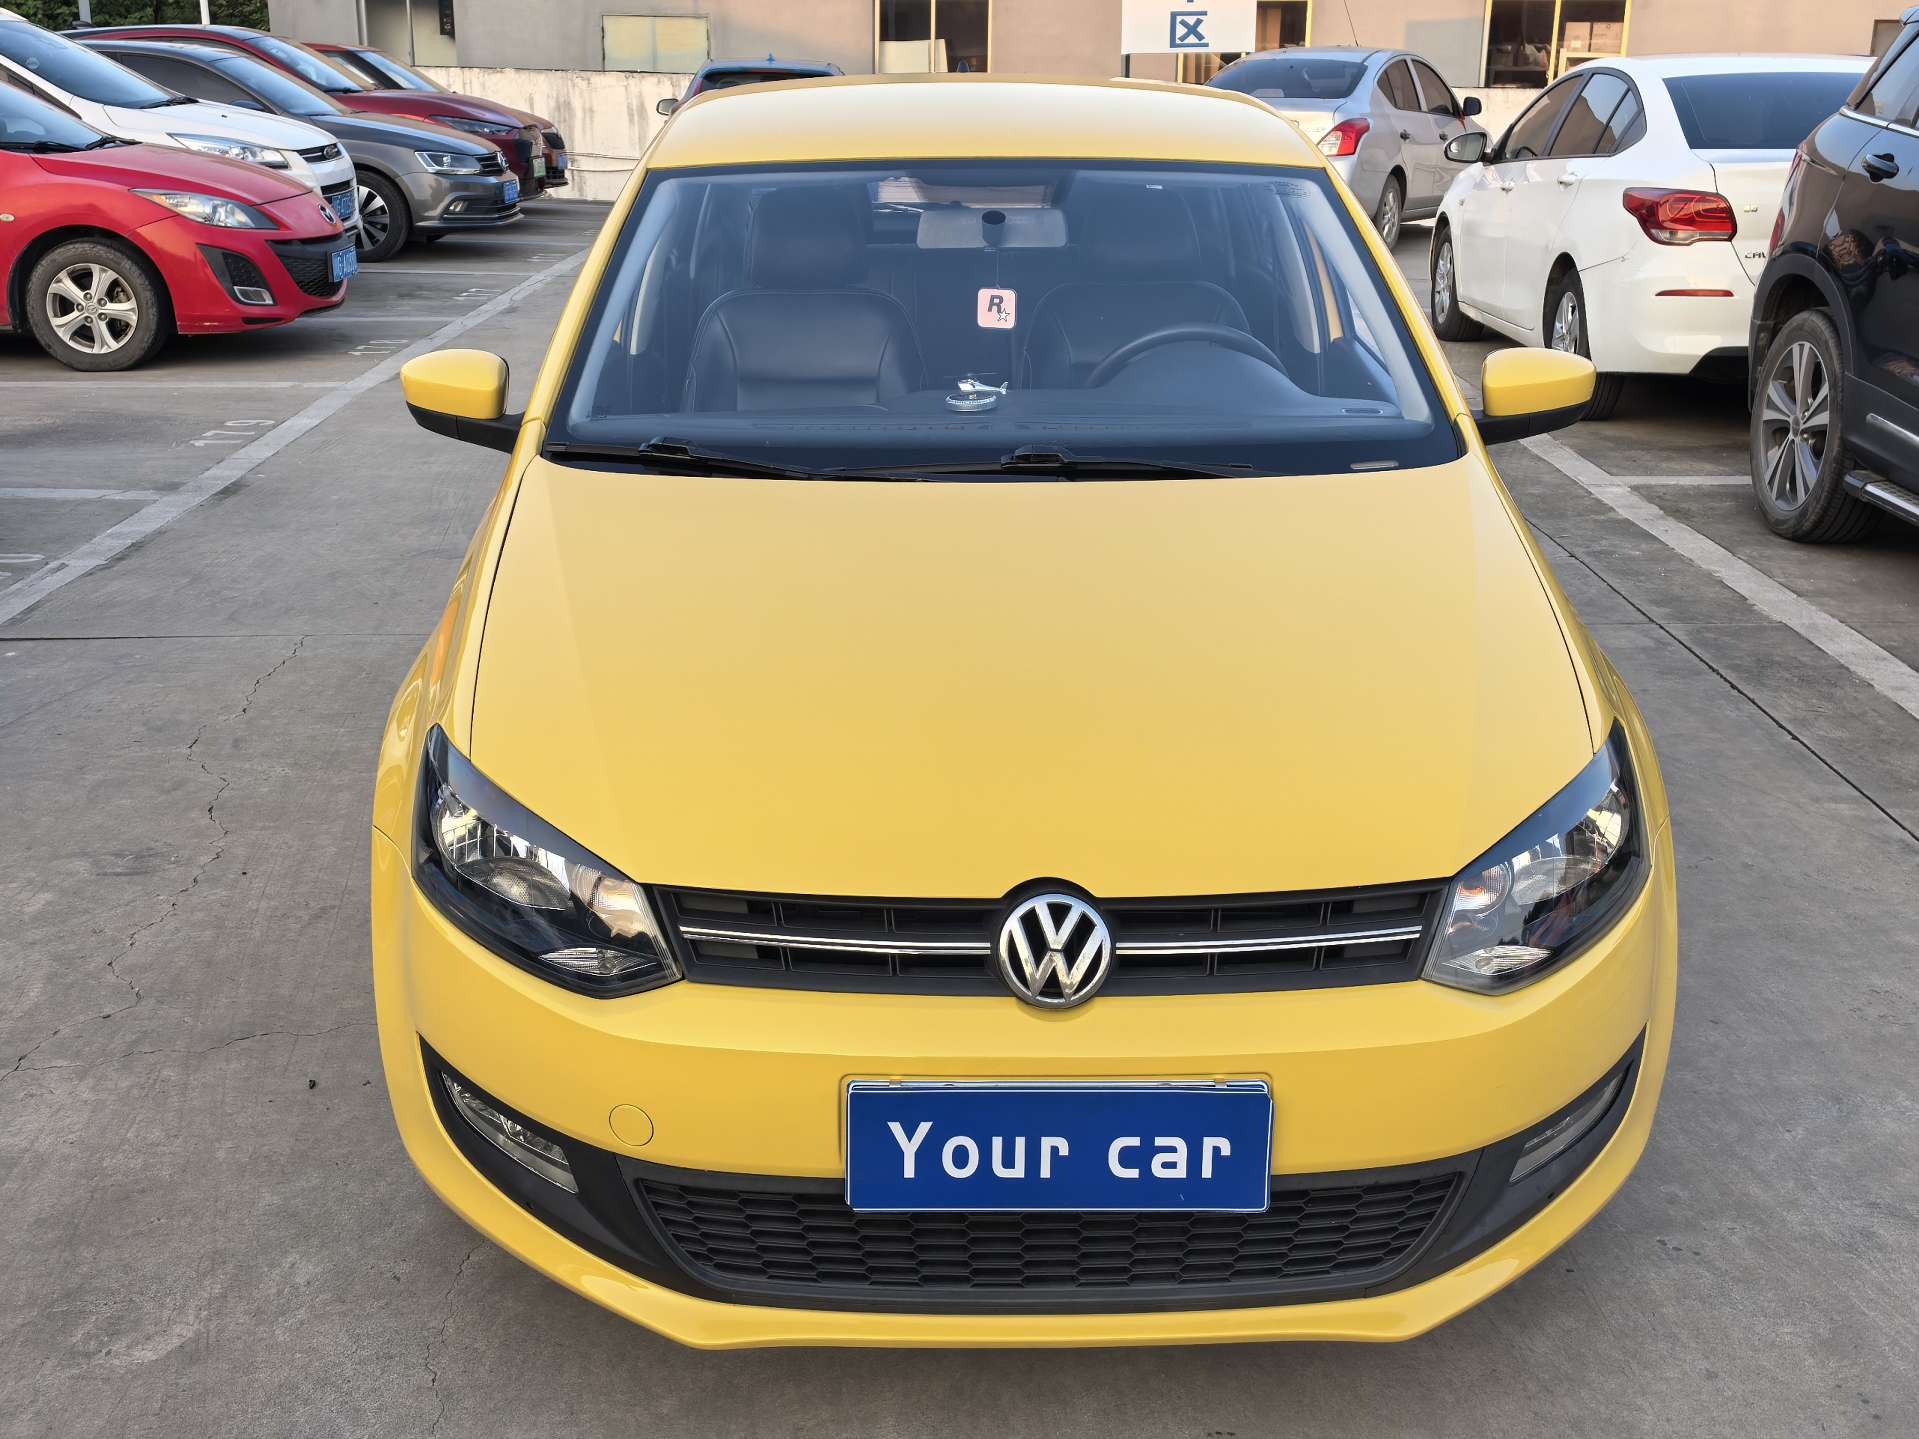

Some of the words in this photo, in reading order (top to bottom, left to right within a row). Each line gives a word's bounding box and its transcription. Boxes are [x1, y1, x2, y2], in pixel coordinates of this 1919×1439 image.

[1169, 11, 1209, 48] 区
[189, 420, 275, 446] 179
[887, 1121, 1070, 1179] Your
[1107, 1135, 1232, 1179] car
